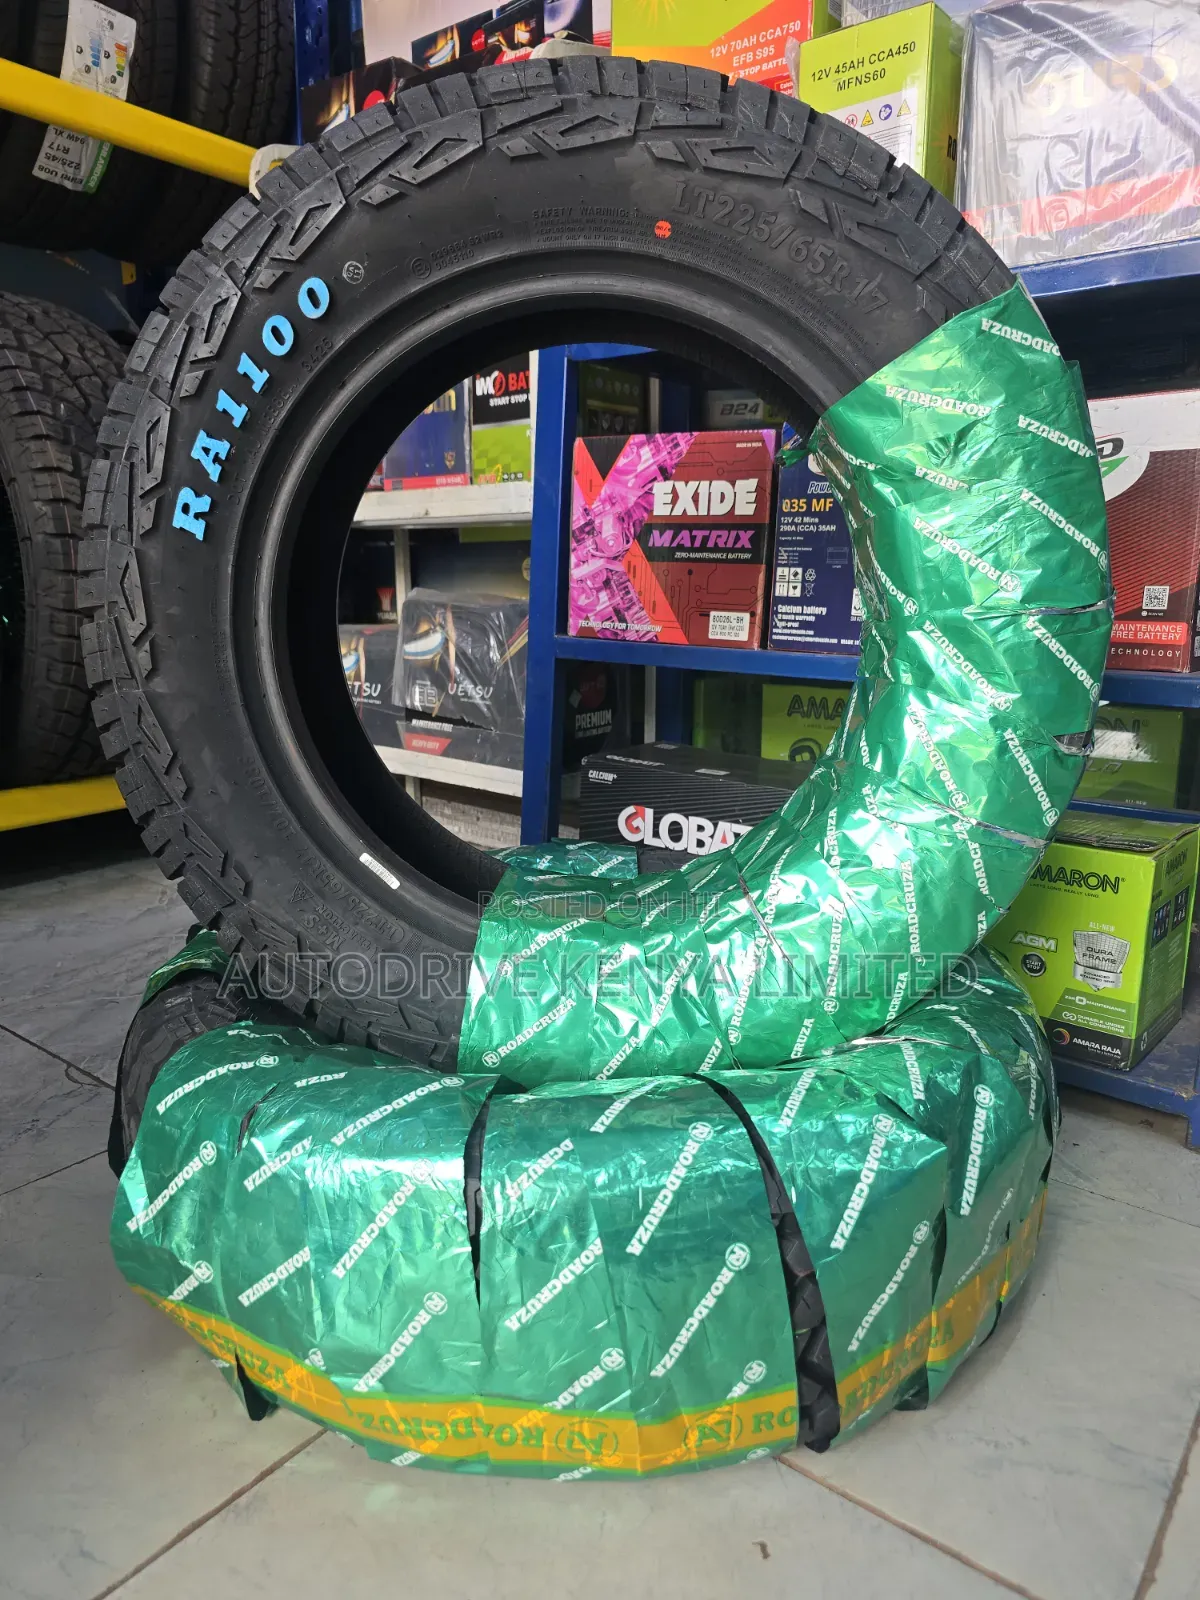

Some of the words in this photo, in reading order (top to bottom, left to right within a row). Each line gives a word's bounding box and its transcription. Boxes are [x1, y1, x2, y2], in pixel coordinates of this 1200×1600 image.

[710, 41, 728, 59] 12V
[730, 33, 757, 52] 70AH
[759, 20, 801, 42] CCA750
[732, 51, 754, 67] EFB
[755, 45, 775, 60] S95
[762, 57, 788, 73] BATTE
[811, 66, 832, 83] 12V
[834, 57, 865, 75] 45AH
[868, 40, 916, 65] CCA450
[836, 67, 886, 92] MFNS60
[45, 152, 81, 170] 225/45
[48, 142, 70, 155] R17
[88, 142, 110, 187] ENLANDER
[532, 207, 573, 219] SAFETY
[670, 178, 890, 315] LT225/65R17
[172, 277, 330, 541] RA1100
[489, 396, 510, 407] START
[511, 394, 527, 404] STOP
[720, 402, 760, 416] B24
[885, 385, 992, 418] ROADCRUZA
[652, 478, 759, 516] EXIDE
[812, 498, 833, 512] MF
[648, 530, 755, 548] MATRIX
[797, 524, 817, 533] (CCA)
[1021, 488, 1099, 557] ROADCRUZA
[913, 516, 1001, 581] ROADCRUZA
[579, 620, 614, 629] TECHNOLOGY
[615, 622, 626, 630] FOR
[627, 623, 662, 632] TOMORROW
[777, 604, 802, 614] Calcium
[803, 606, 827, 616] battery
[1112, 622, 1183, 634] MAINTENANCE
[1025, 615, 1093, 689] ROADCRUZA
[1111, 631, 1134, 640] FREE
[1137, 632, 1182, 641] BATTERY
[1111, 648, 1181, 658] ECHNOLOGY
[923, 620, 998, 701] ROADCRUZA
[448, 683, 493, 699] UETSU
[575, 709, 612, 730] PREMIUM
[1003, 727, 1052, 812] ROADCRUZA
[1032, 864, 1120, 894] MARON
[901, 859, 921, 956] ROADCRUZA
[1089, 921, 1115, 932] ALL-NEW
[301, 912, 347, 951] M+S
[513, 917, 589, 965] ROADCRUZA
[1014, 932, 1057, 951] AGM
[1026, 959, 1041, 967] START
[1082, 952, 1117, 965] FRAME
[1086, 946, 1114, 957] DURA
[499, 997, 577, 1057] ROADCRUZA
[1073, 1037, 1101, 1050] AMARA
[1101, 1045, 1121, 1055] RAJA
[156, 1060, 256, 1115] ROADCRUZA
[330, 1081, 443, 1146] ROADCRUZA
[960, 1104, 988, 1217] ROADCRUZA
[126, 1155, 203, 1233] ROADCRUZA
[625, 1137, 701, 1257] ROADCRUZA
[830, 1132, 886, 1251] ROADCRUZA
[331, 1180, 416, 1279] ROADCRUZA
[238, 1246, 311, 1307] ROADCRUZA
[505, 1237, 603, 1331] ROADCRUZA
[848, 1244, 918, 1353] ROADCRUZA
[650, 1267, 734, 1378] ROADCRUZA
[353, 1309, 432, 1392] ROADCRUZA
